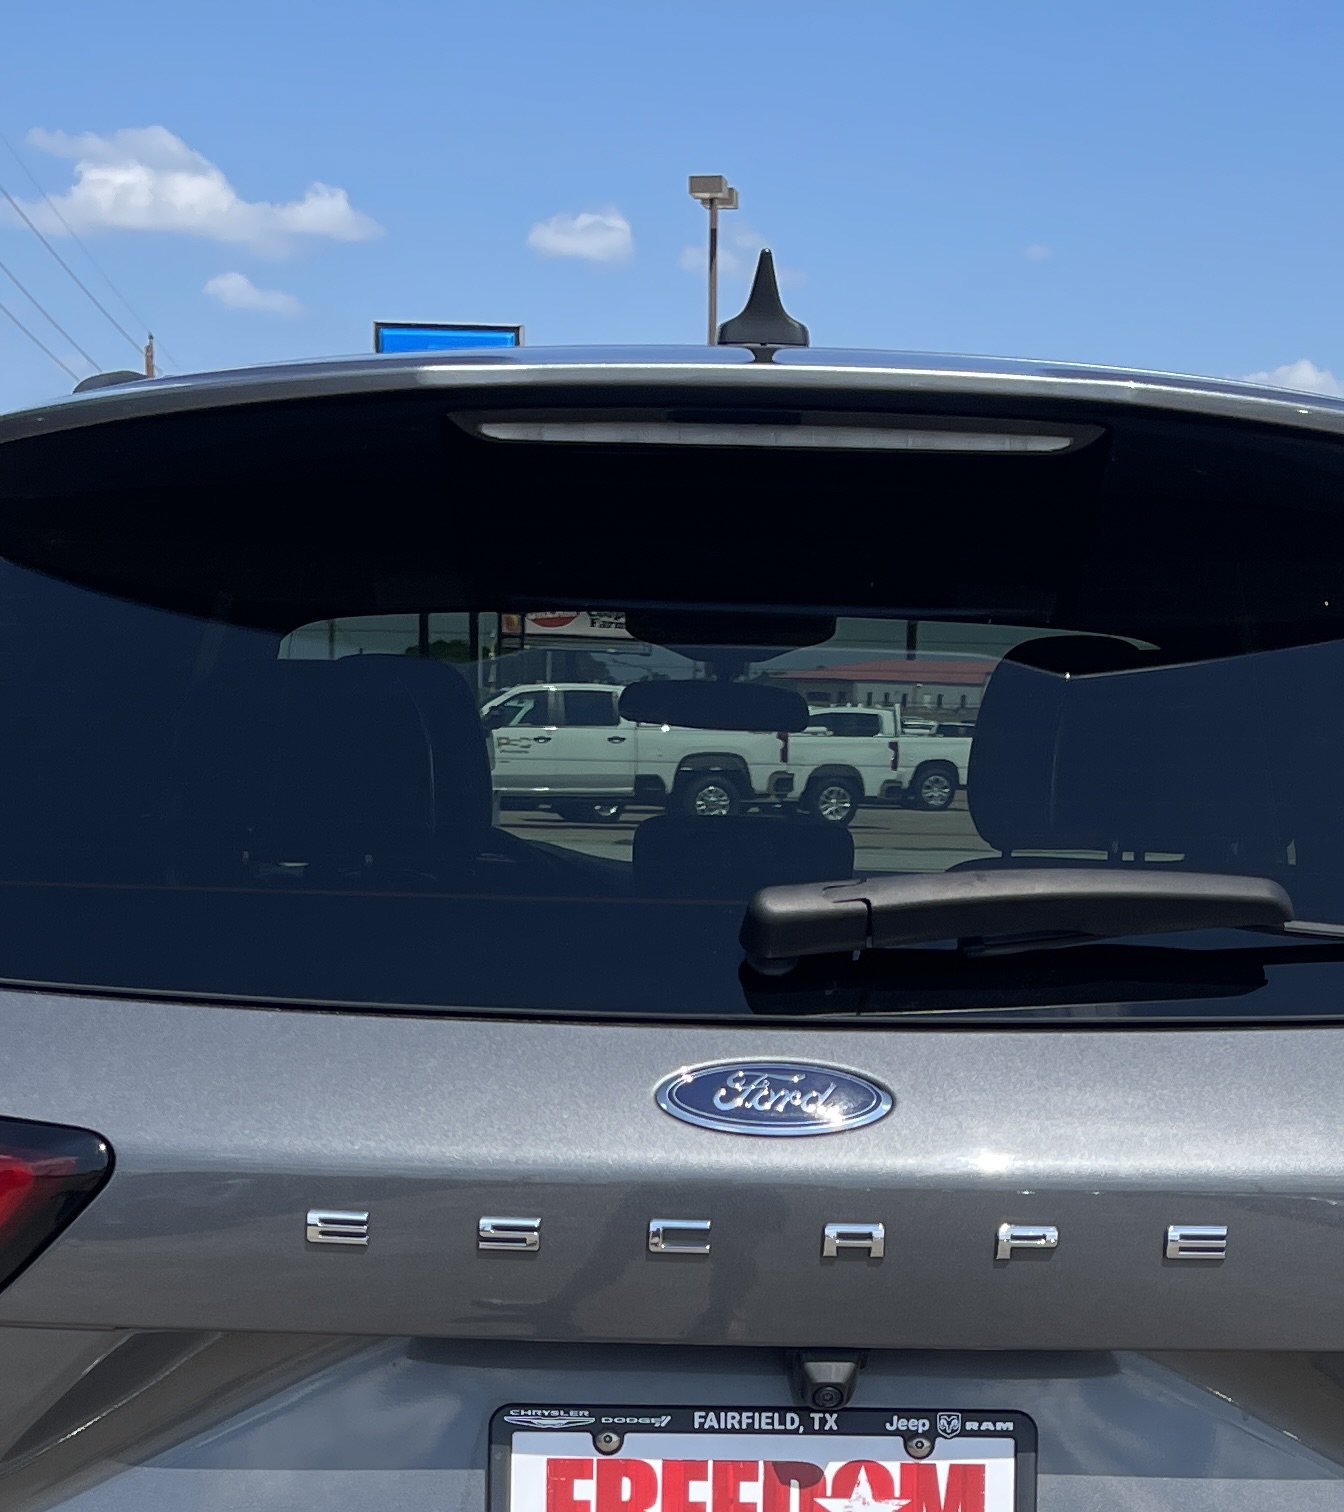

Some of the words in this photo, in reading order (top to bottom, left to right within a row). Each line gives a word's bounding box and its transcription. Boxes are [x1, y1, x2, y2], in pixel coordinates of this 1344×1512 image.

[713, 1071, 838, 1113] Ford
[306, 1209, 1229, 1260] ESCAPE
[509, 1409, 590, 1417] CHRYSLER
[601, 1416, 661, 1425] DODGE
[694, 1411, 805, 1433] FAIRFIELD,
[810, 1412, 839, 1431] TX
[885, 1414, 931, 1433] Jeep
[965, 1421, 1014, 1431] RAM
